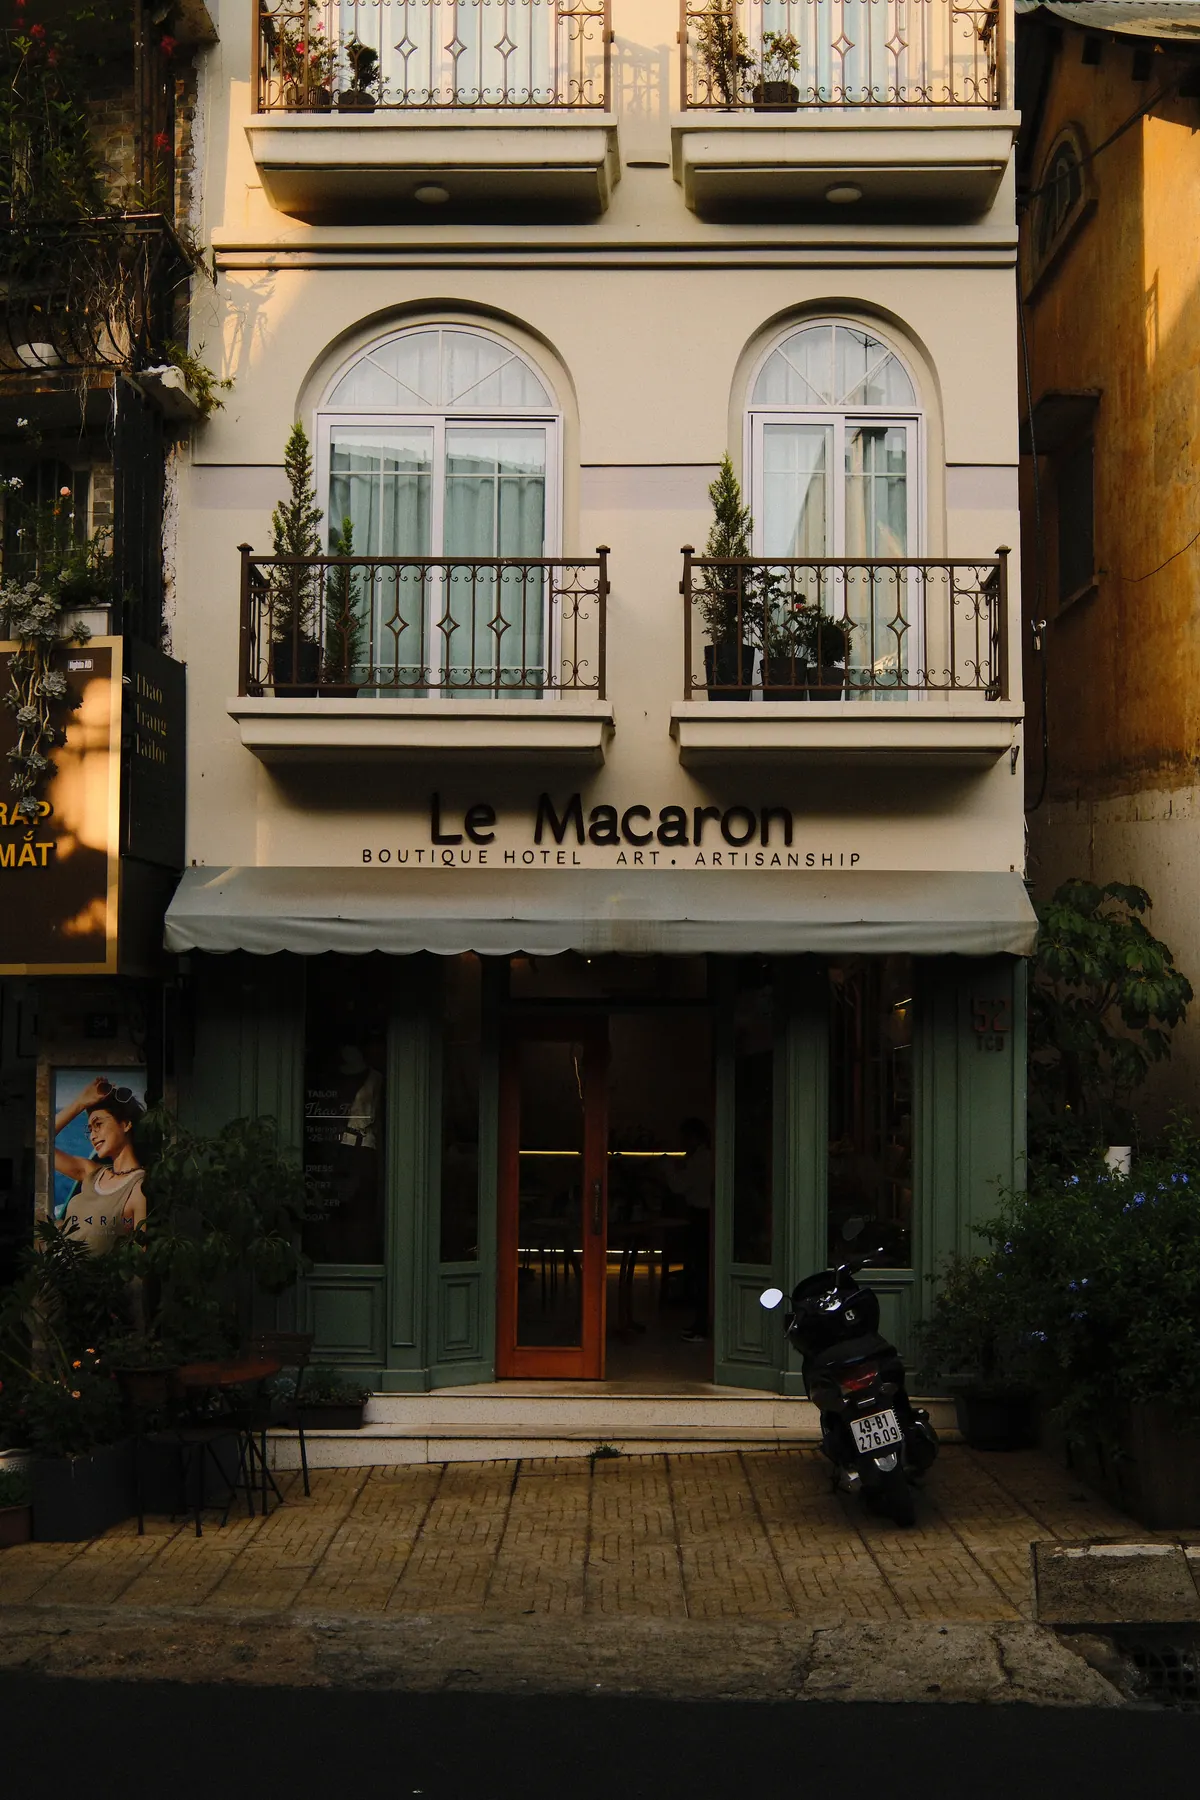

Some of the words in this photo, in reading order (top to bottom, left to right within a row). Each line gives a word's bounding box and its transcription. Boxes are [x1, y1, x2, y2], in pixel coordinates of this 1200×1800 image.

[431, 792, 496, 845] Le
[534, 792, 793, 847] Macaron
[0, 830, 55, 868] MẮT
[362, 849, 488, 867] BOUTIQUE
[504, 850, 582, 865] HOTEL
[695, 852, 861, 867] ARTISANSHIP
[307, 1090, 338, 1099] TAILOR
[859, 1414, 889, 1434] 49-B1
[859, 1427, 898, 1450] 276.09
